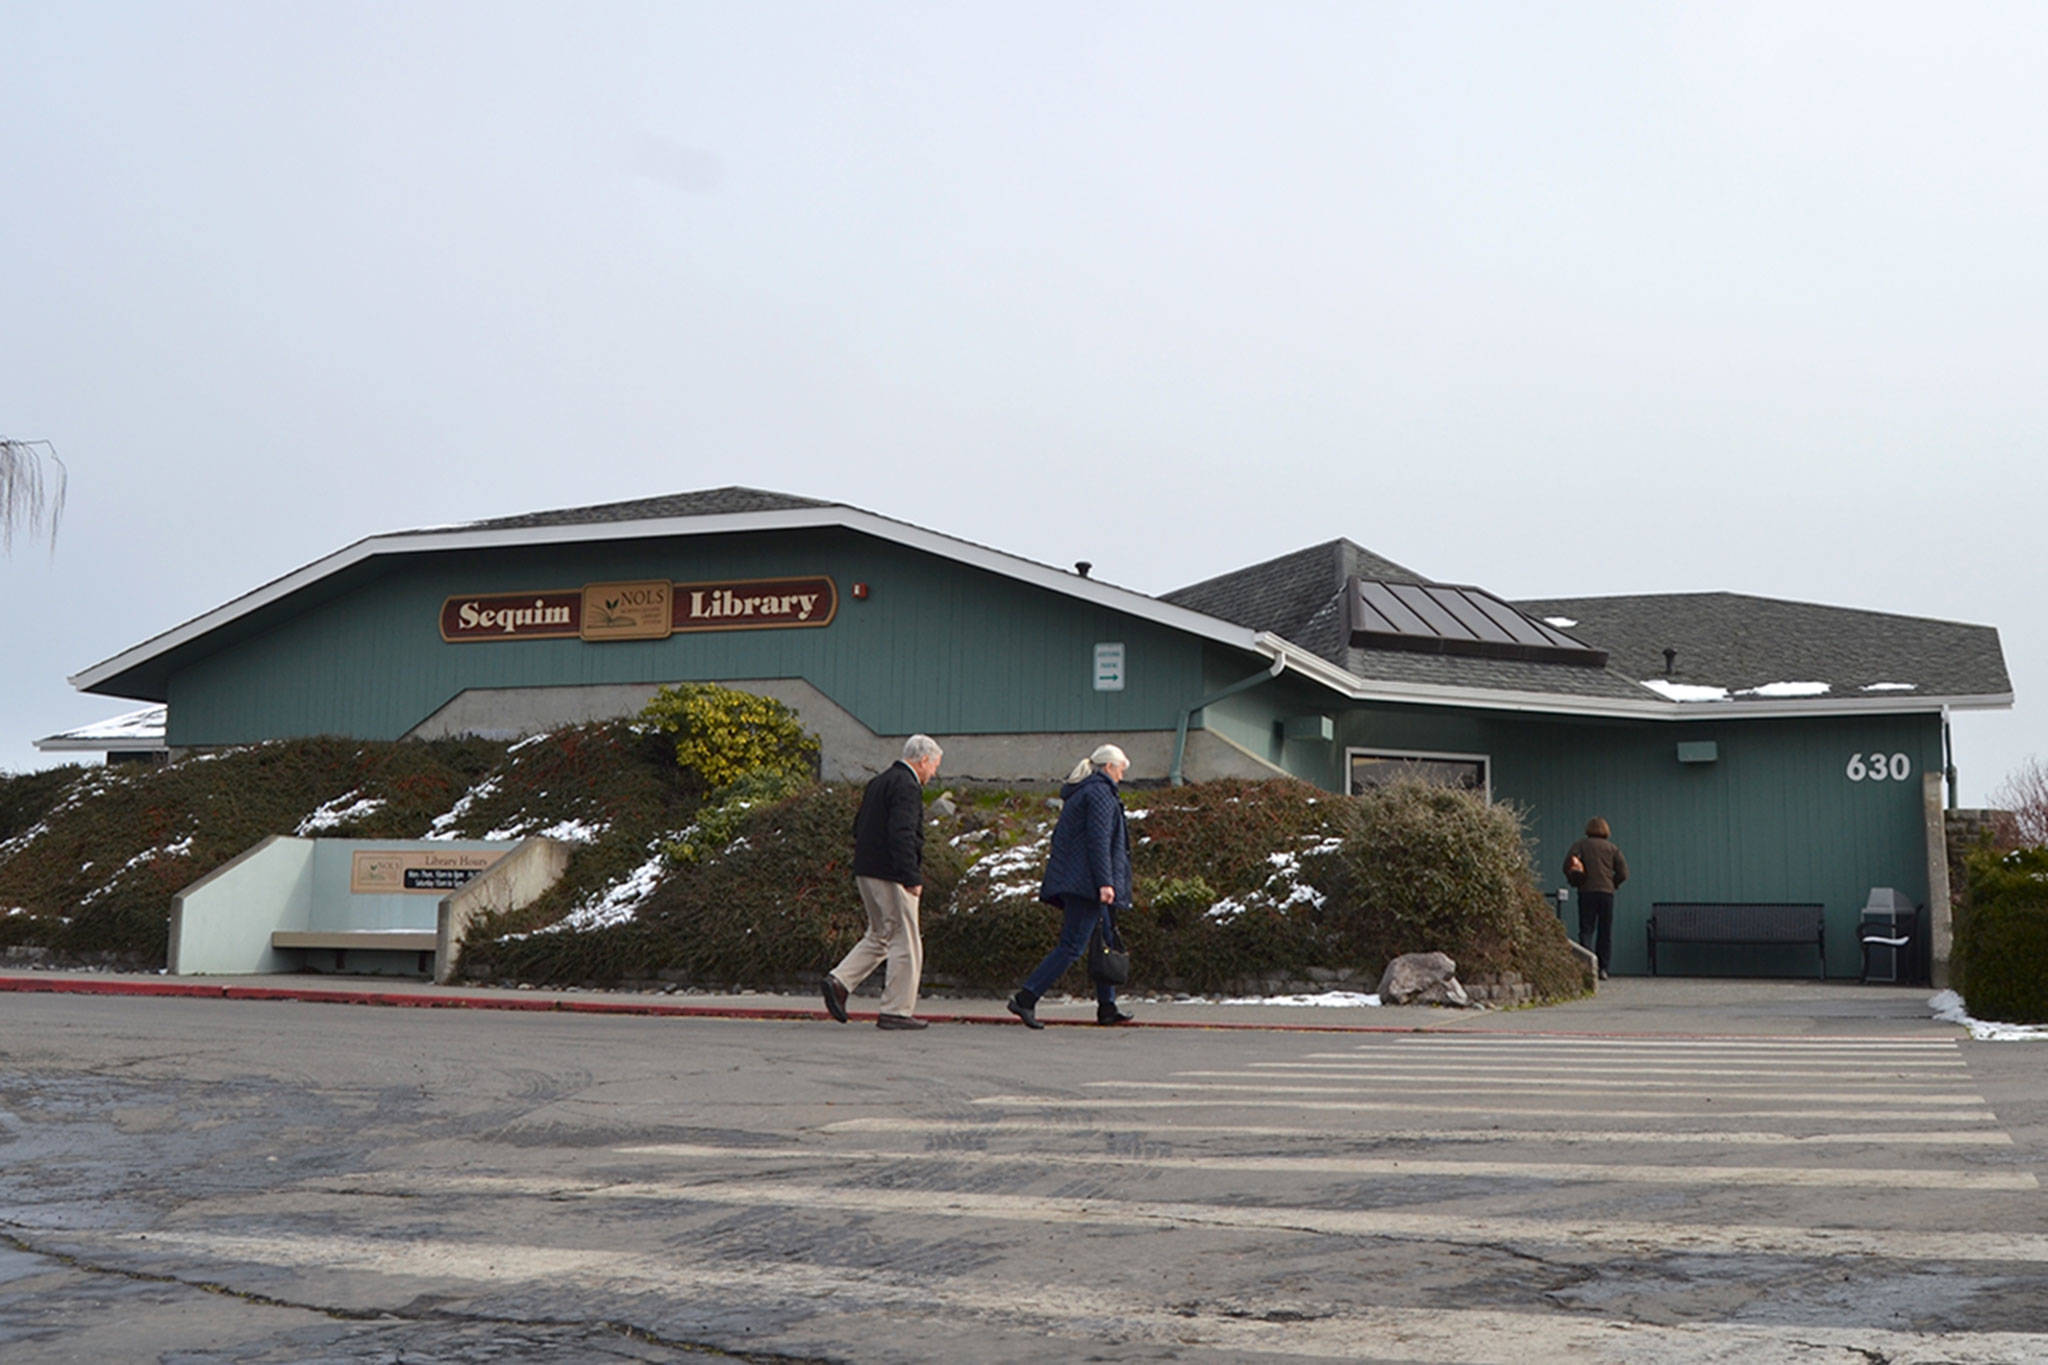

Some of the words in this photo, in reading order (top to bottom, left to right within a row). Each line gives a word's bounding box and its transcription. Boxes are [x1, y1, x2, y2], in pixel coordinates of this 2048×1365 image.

[620, 589, 665, 606] NOLS
[458, 600, 571, 633] Sequim
[689, 590, 819, 621] Library
[1846, 752, 1911, 781] 630
[425, 856, 457, 867] Library
[459, 856, 487, 866] Hours
